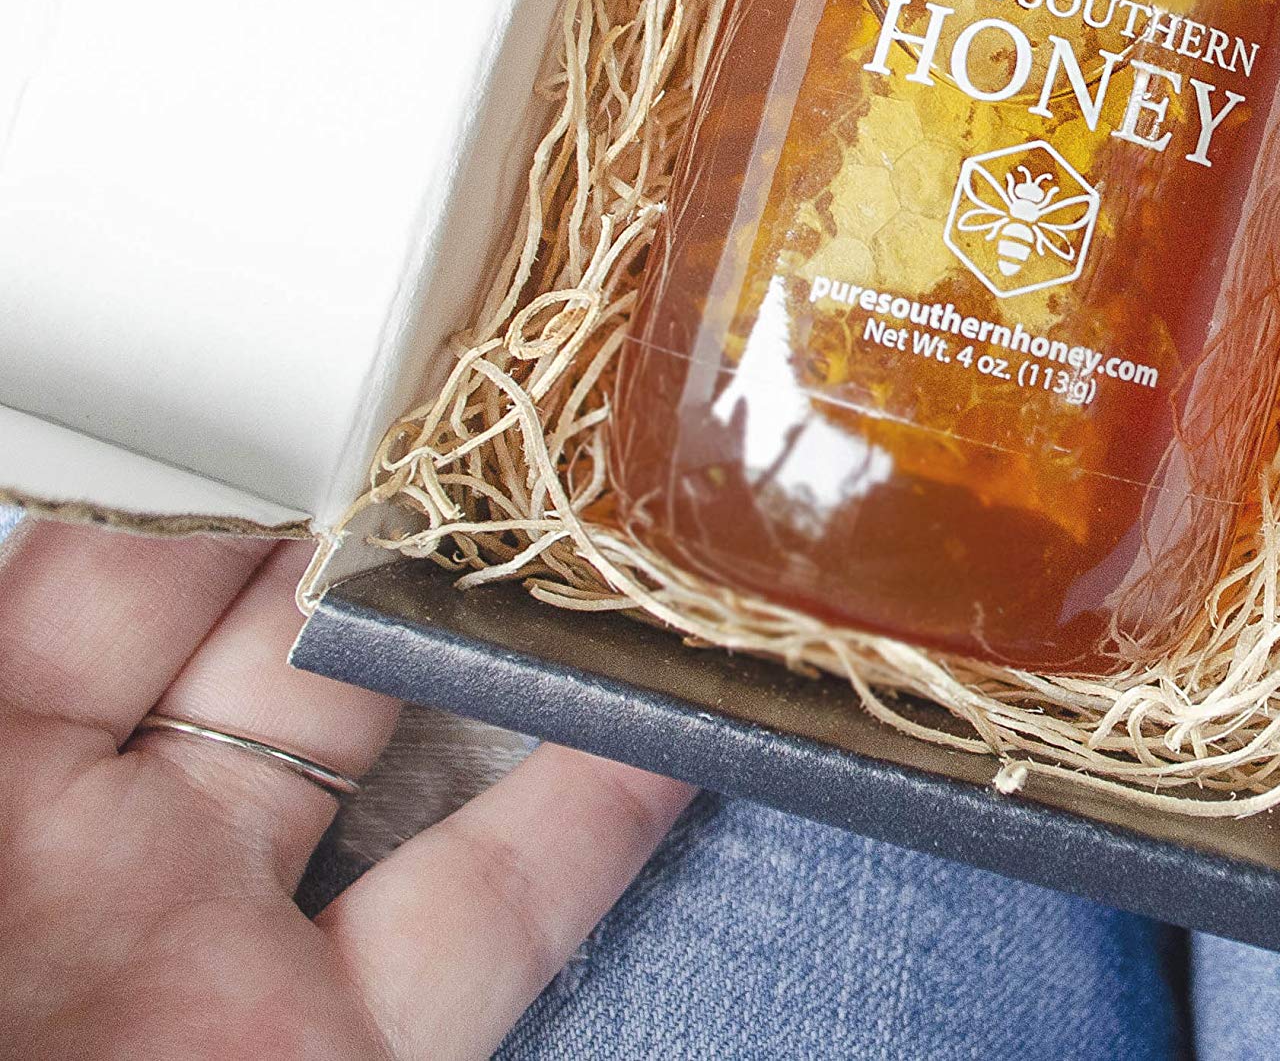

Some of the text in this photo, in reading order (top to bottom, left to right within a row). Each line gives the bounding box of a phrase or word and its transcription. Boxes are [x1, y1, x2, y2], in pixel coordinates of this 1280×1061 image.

[809, 275, 1159, 388] puresouthernhoney.com
[863, 317, 1097, 406] Net Wt. 4 oz. (113g)
